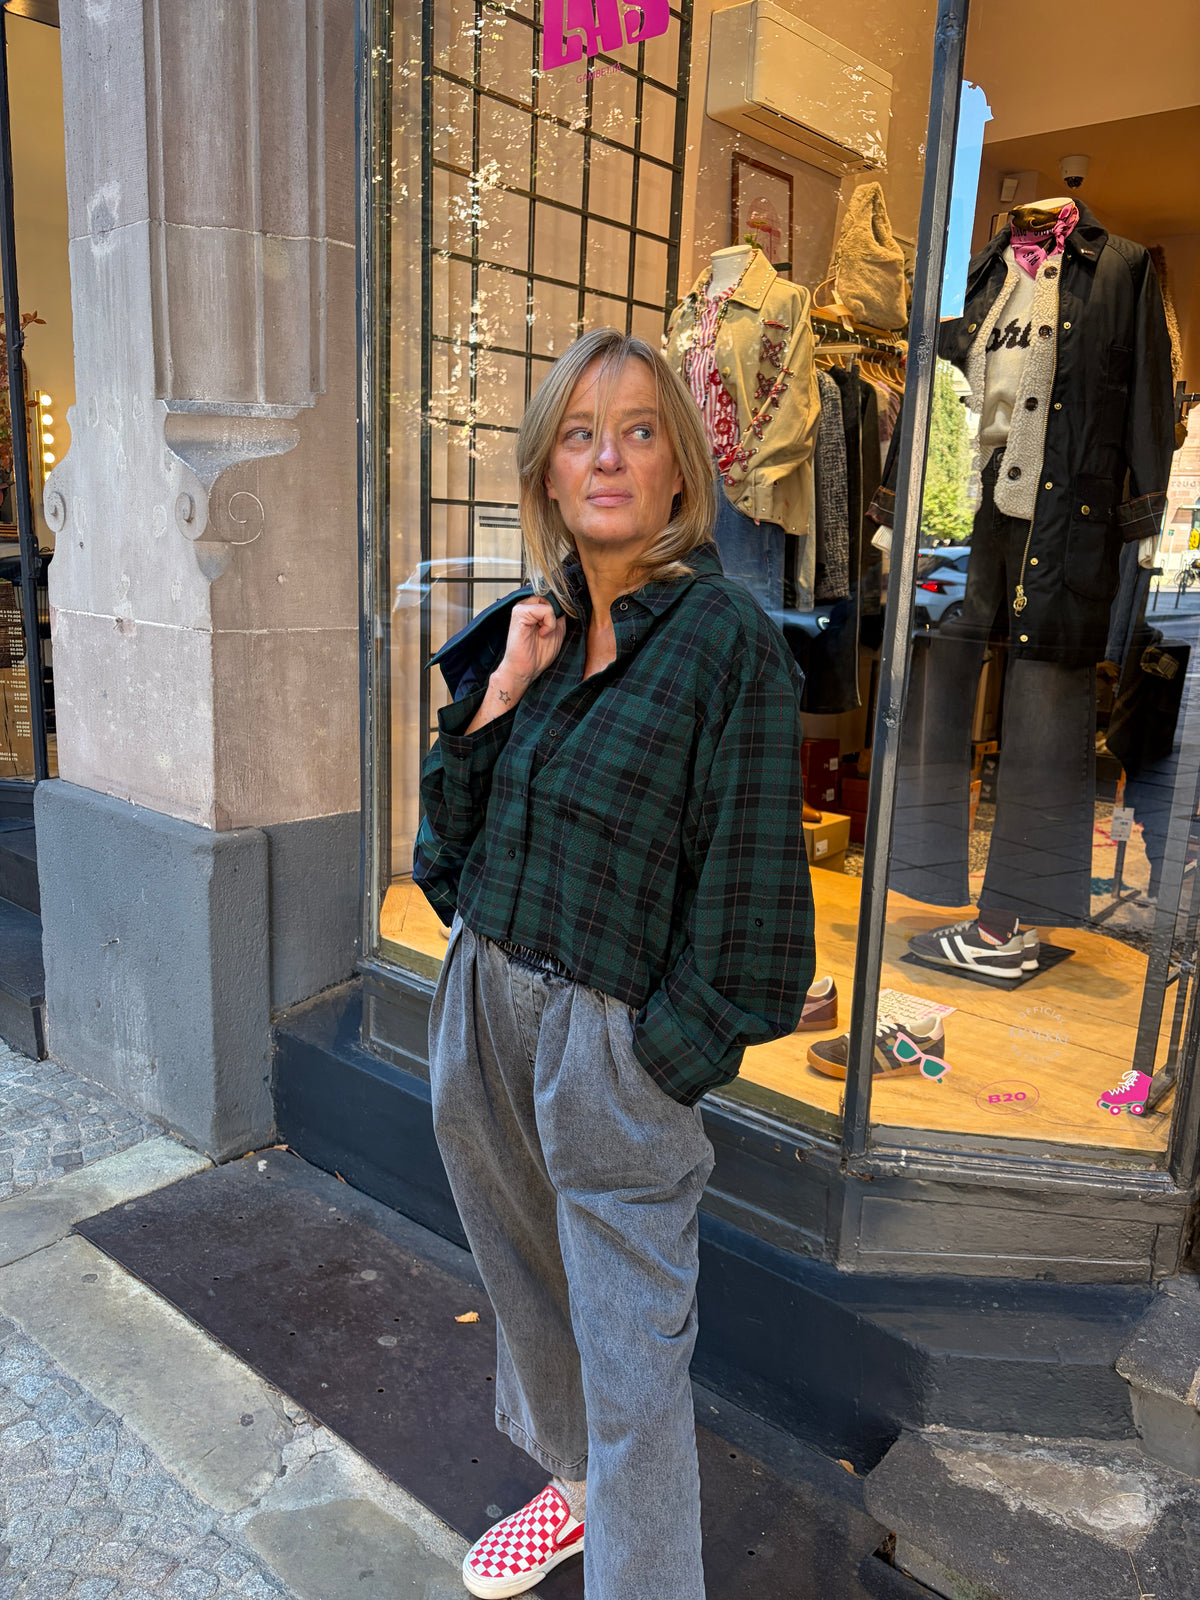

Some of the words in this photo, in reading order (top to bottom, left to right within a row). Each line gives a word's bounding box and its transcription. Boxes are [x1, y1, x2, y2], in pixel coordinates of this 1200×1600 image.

[576, 62, 621, 84] GAMBETTA
[1017, 1006, 1066, 1025] OFFICIAL
[988, 1092, 1026, 1105] B20
